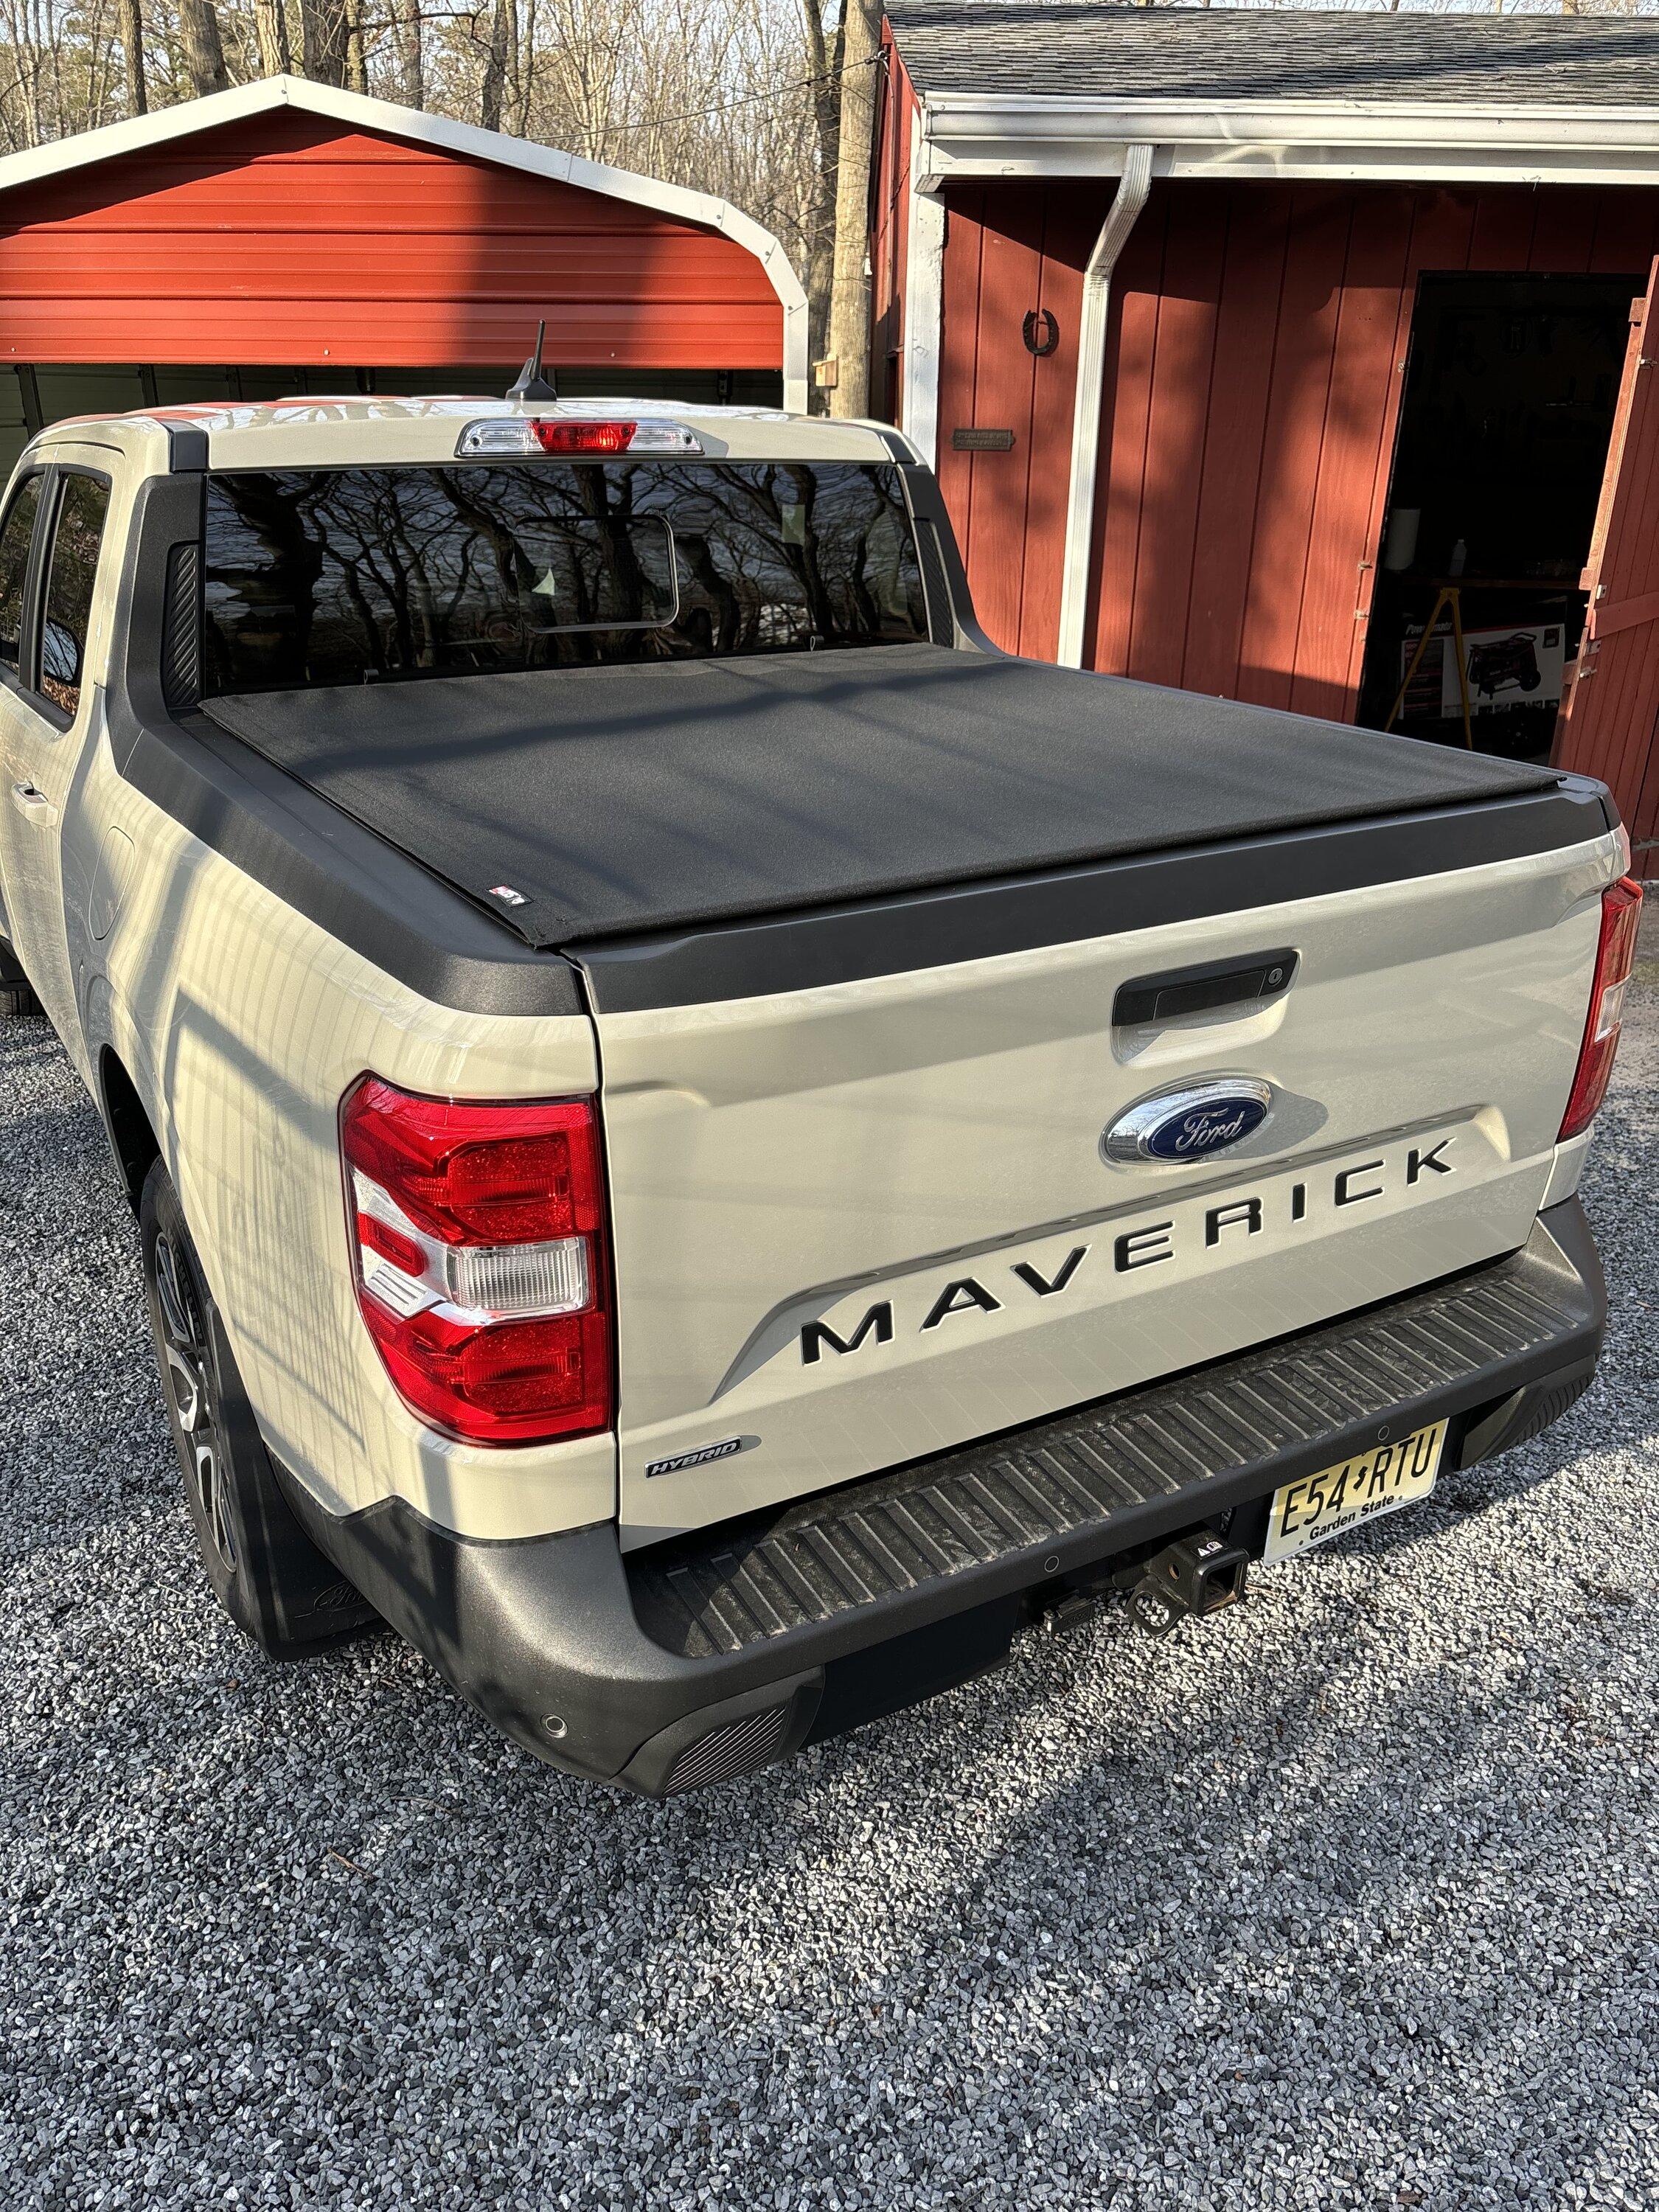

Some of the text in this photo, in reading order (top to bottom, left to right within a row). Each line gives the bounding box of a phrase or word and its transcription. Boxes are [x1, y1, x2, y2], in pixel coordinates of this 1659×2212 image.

[1175, 1107, 1246, 1152] Ford
[801, 1138, 1458, 1366] MAVERICK
[650, 1442, 738, 1475] HYBRID
[1310, 1495, 1395, 1540] Garden State
